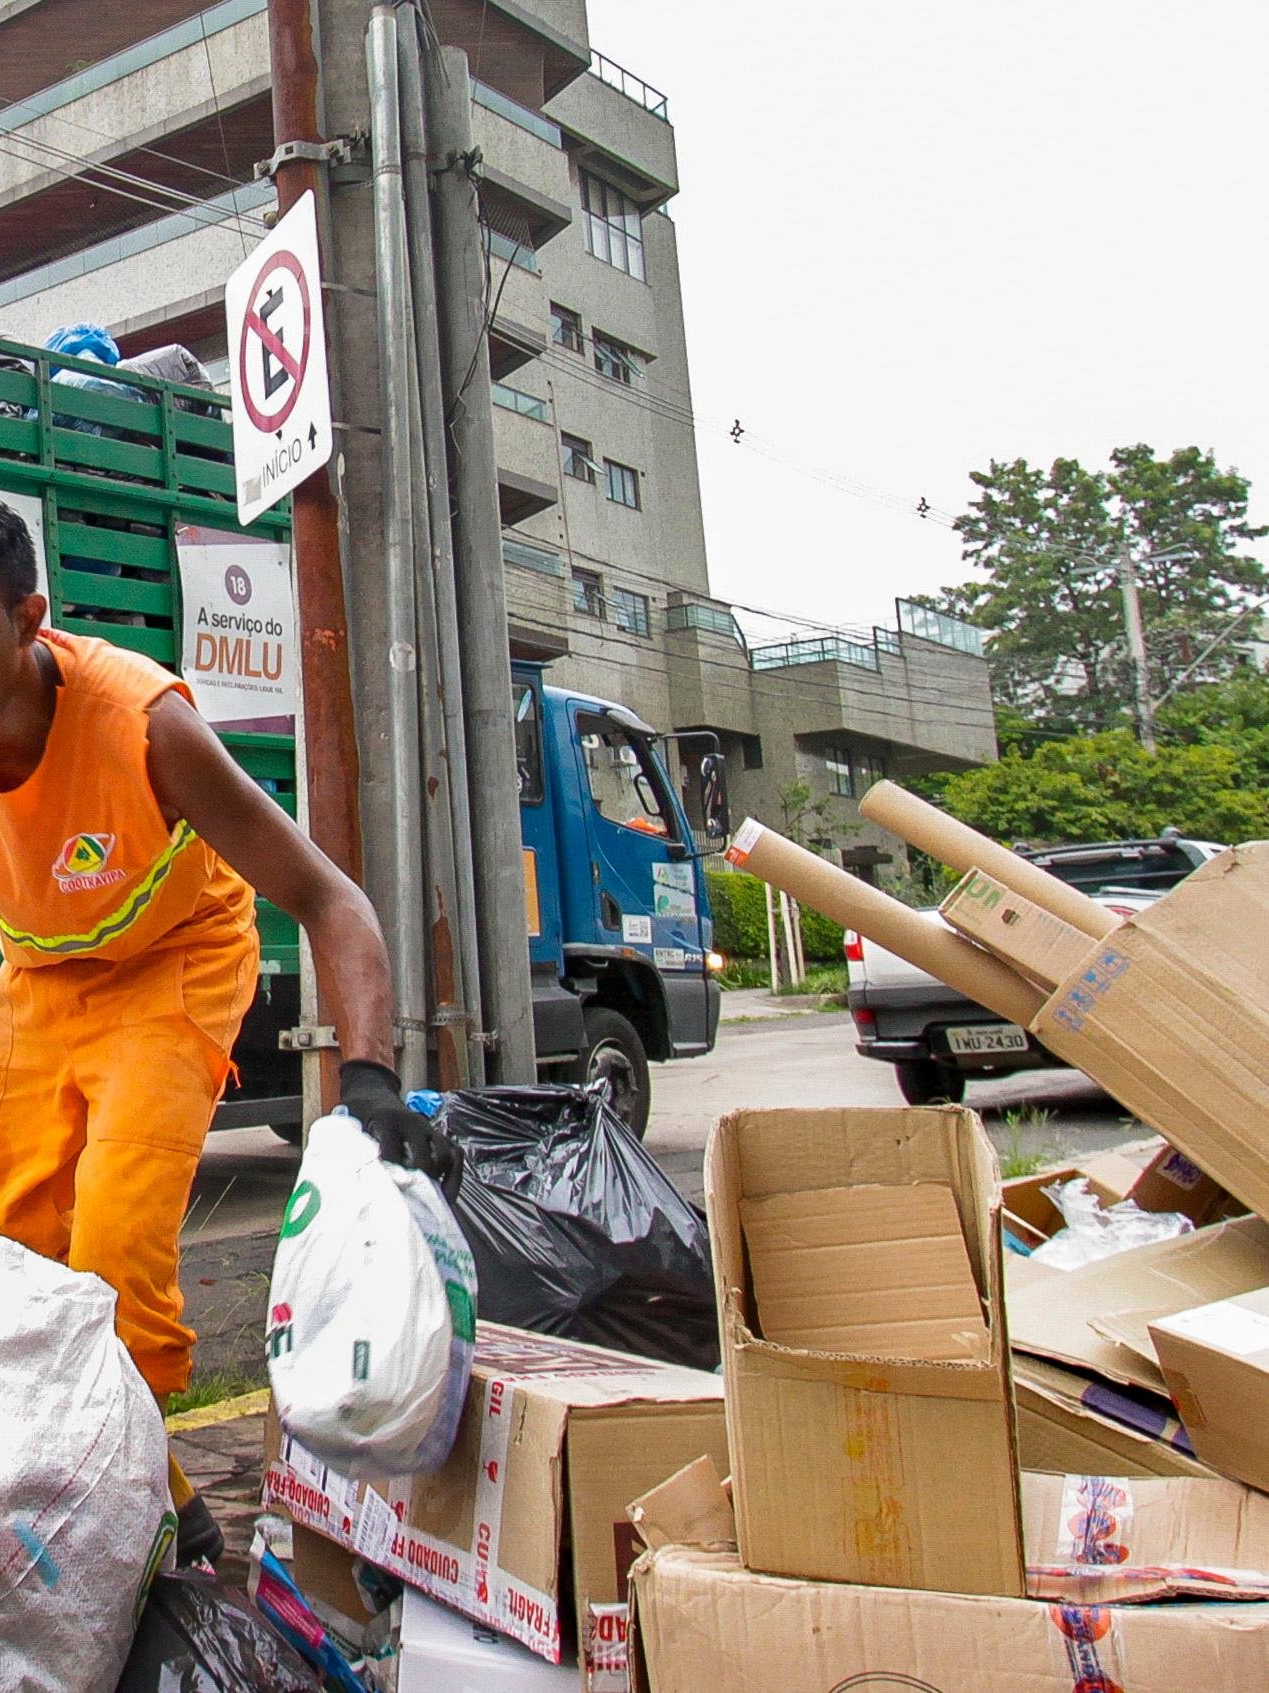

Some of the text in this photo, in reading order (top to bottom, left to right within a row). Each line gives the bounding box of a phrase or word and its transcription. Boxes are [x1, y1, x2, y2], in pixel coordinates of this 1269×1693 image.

[262, 437, 303, 489] INÍCIO
[229, 574, 247, 596] 18
[197, 607, 283, 638] A serviço do
[194, 632, 283, 681] DMLU
[288, 1478, 331, 1520] CUIDADO
[408, 1539, 459, 1585] CUIDADO
[507, 1586, 551, 1638] FRAGIL
